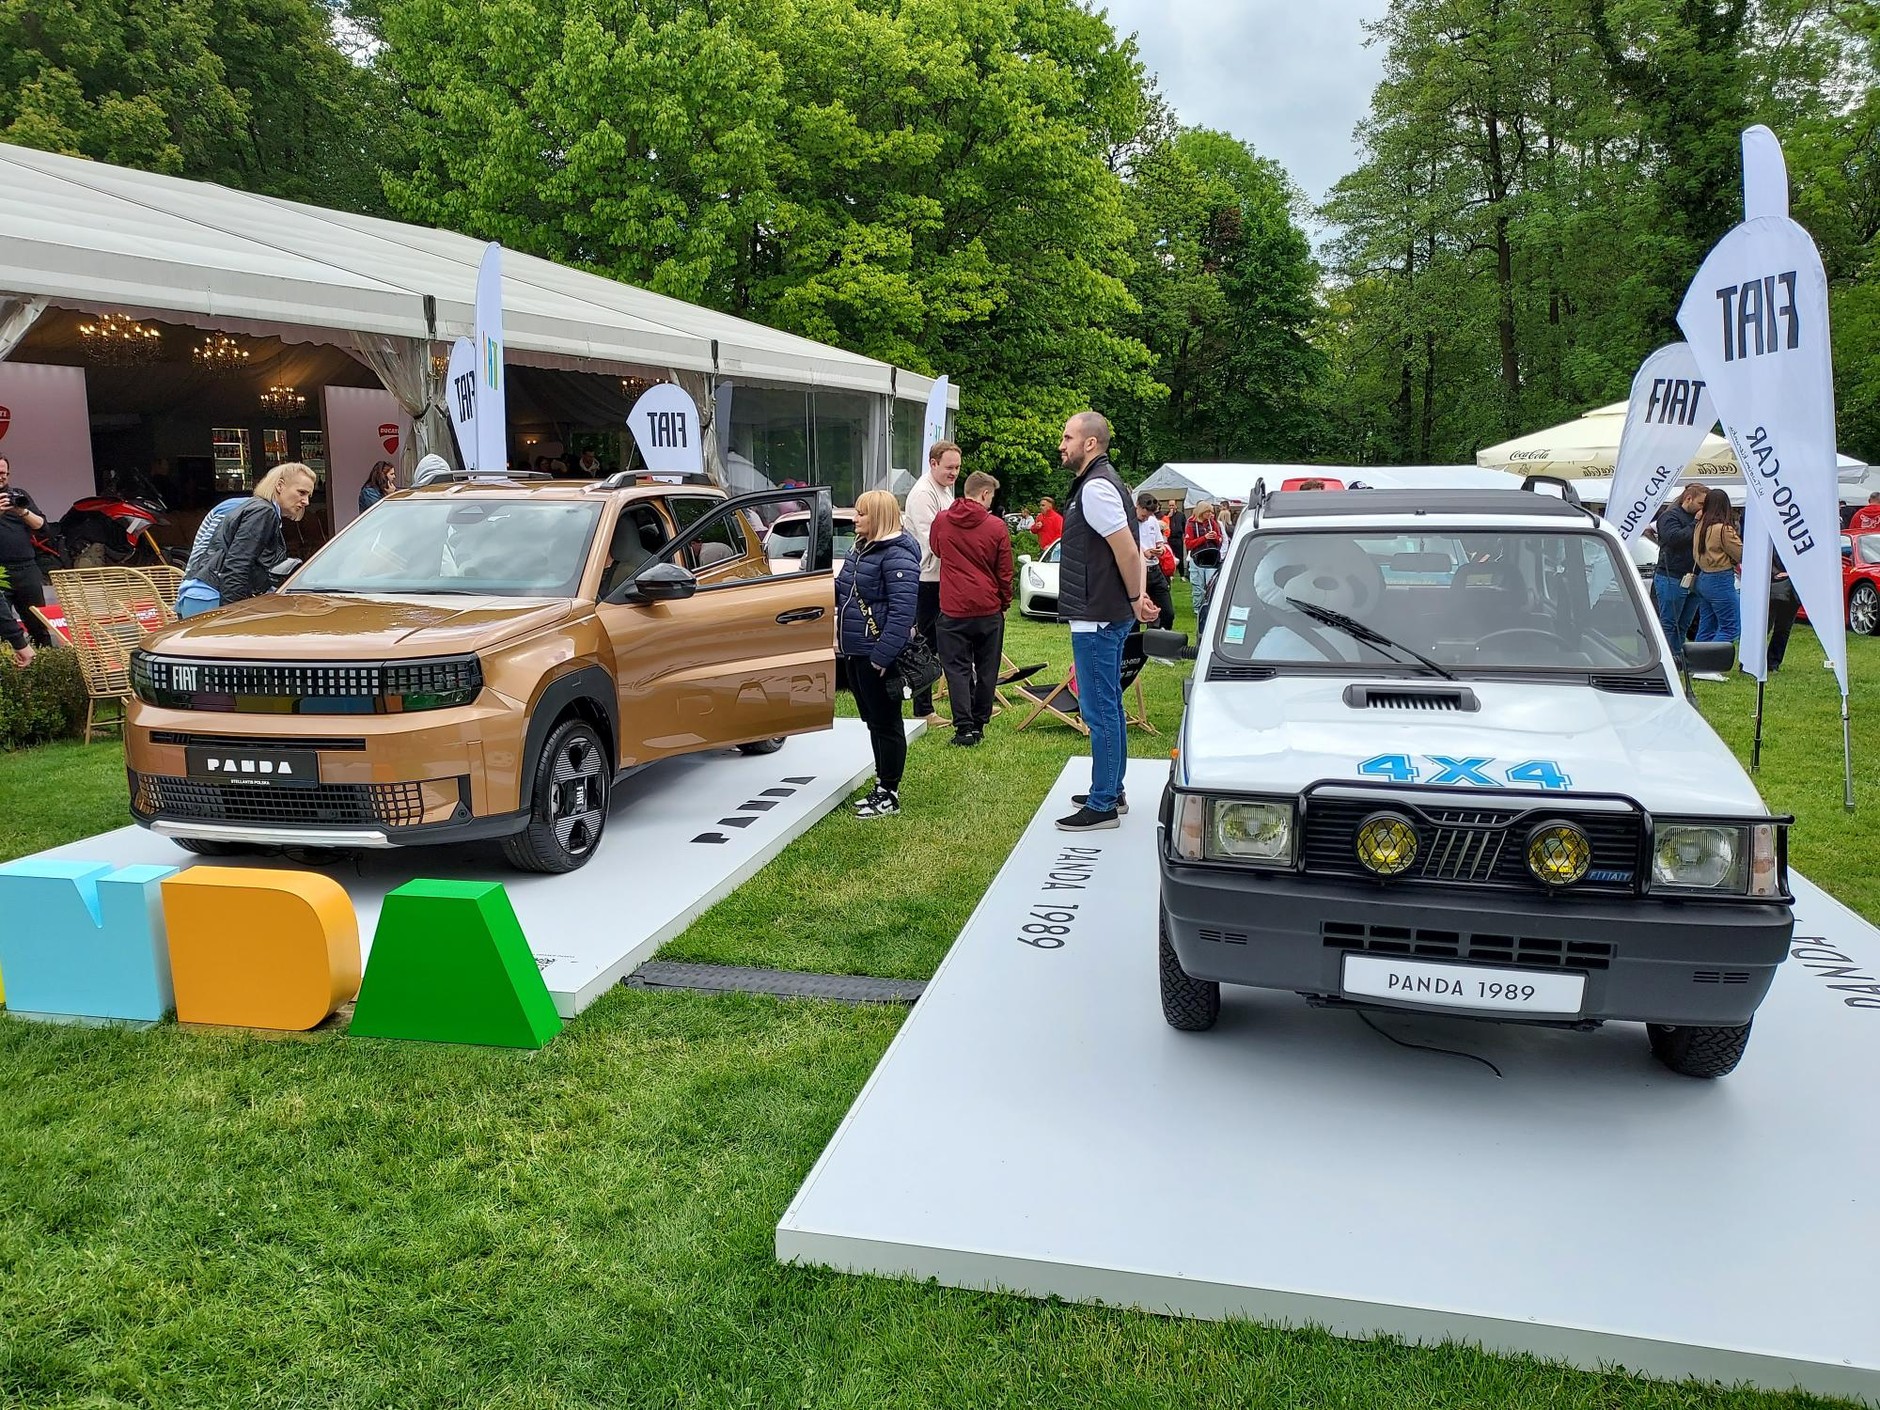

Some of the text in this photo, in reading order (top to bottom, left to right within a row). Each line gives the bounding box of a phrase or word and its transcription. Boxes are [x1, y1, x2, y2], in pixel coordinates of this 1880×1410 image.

[1645, 378, 1706, 426] FIAT
[50, 618, 67, 628] DUC
[172, 666, 198, 691] FIAT
[207, 758, 292, 774] PANDA
[576, 786, 584, 805] FIAT
[1587, 870, 1632, 881] FIAT
[1017, 847, 1102, 949] PANDA 1989
[1388, 973, 1535, 1001] PANDA 1989
